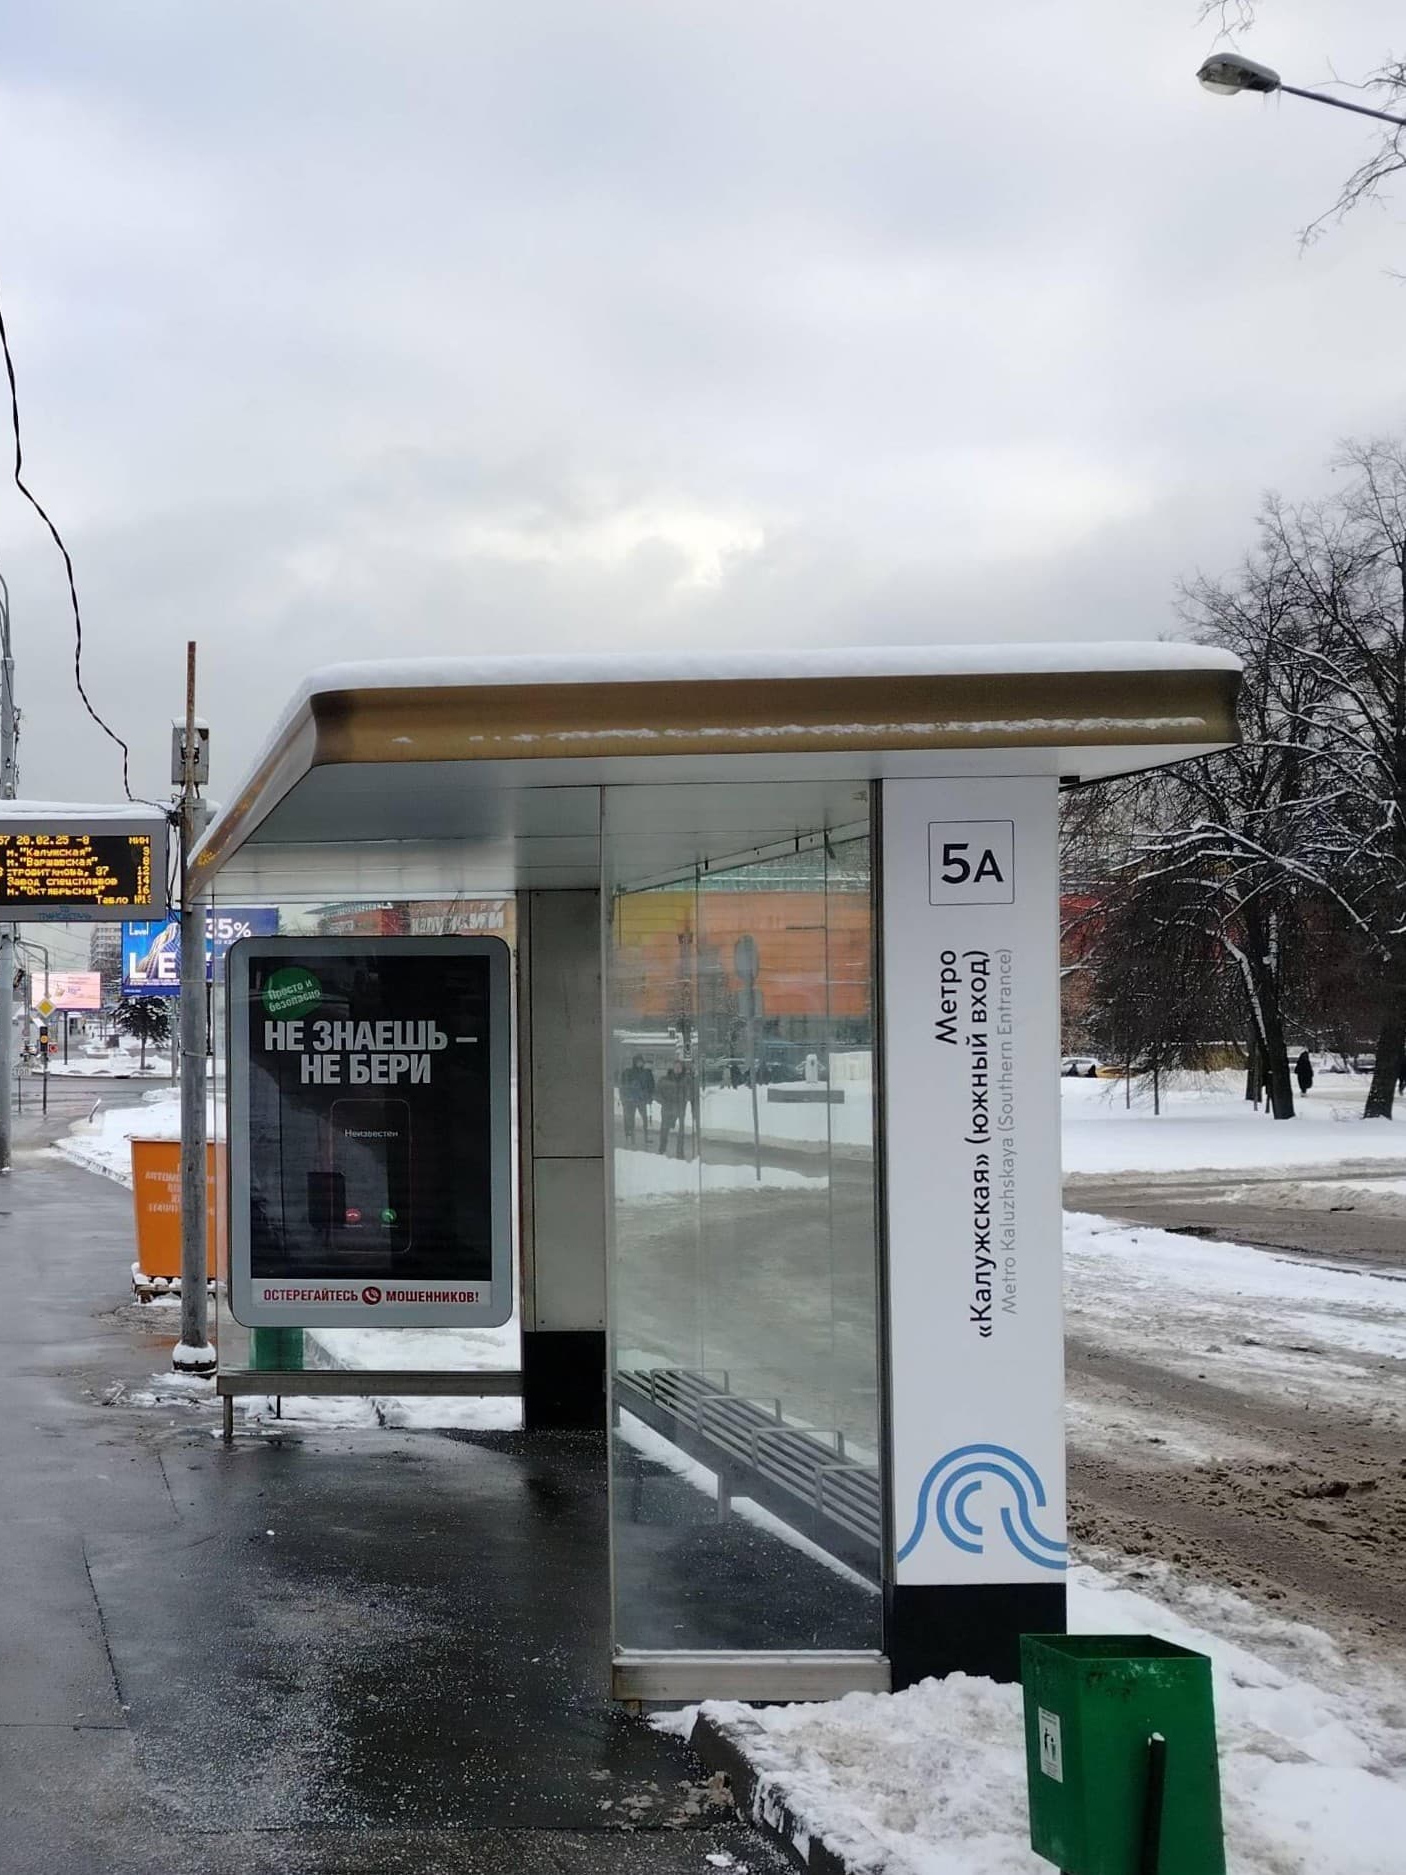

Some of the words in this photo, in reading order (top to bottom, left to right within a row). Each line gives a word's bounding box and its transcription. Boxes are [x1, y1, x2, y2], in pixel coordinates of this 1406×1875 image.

[268, 983, 304, 1000] Просто
[269, 989, 321, 1012] безопасно
[935, 950, 962, 1045] Метро
[962, 951, 990, 1023] вход)
[995, 949, 1013, 1035] Entrance)
[264, 1020, 305, 1050] НЕ
[312, 1020, 449, 1051] ЗНАЕШЬ
[300, 1053, 341, 1084] НЕ
[349, 1053, 431, 1084] БЕРИ
[964, 1033, 991, 1144] (южный
[996, 1041, 1015, 1132] (Southern
[998, 1137, 1018, 1251] Kaluzhskaya
[970, 1154, 997, 1338] «Калужская»
[264, 1288, 358, 1301] ОСТЕРЕГАЙТЕСЬ
[385, 1290, 479, 1303] МОШЕННИКОВ!
[1001, 1256, 1018, 1315] Metro
